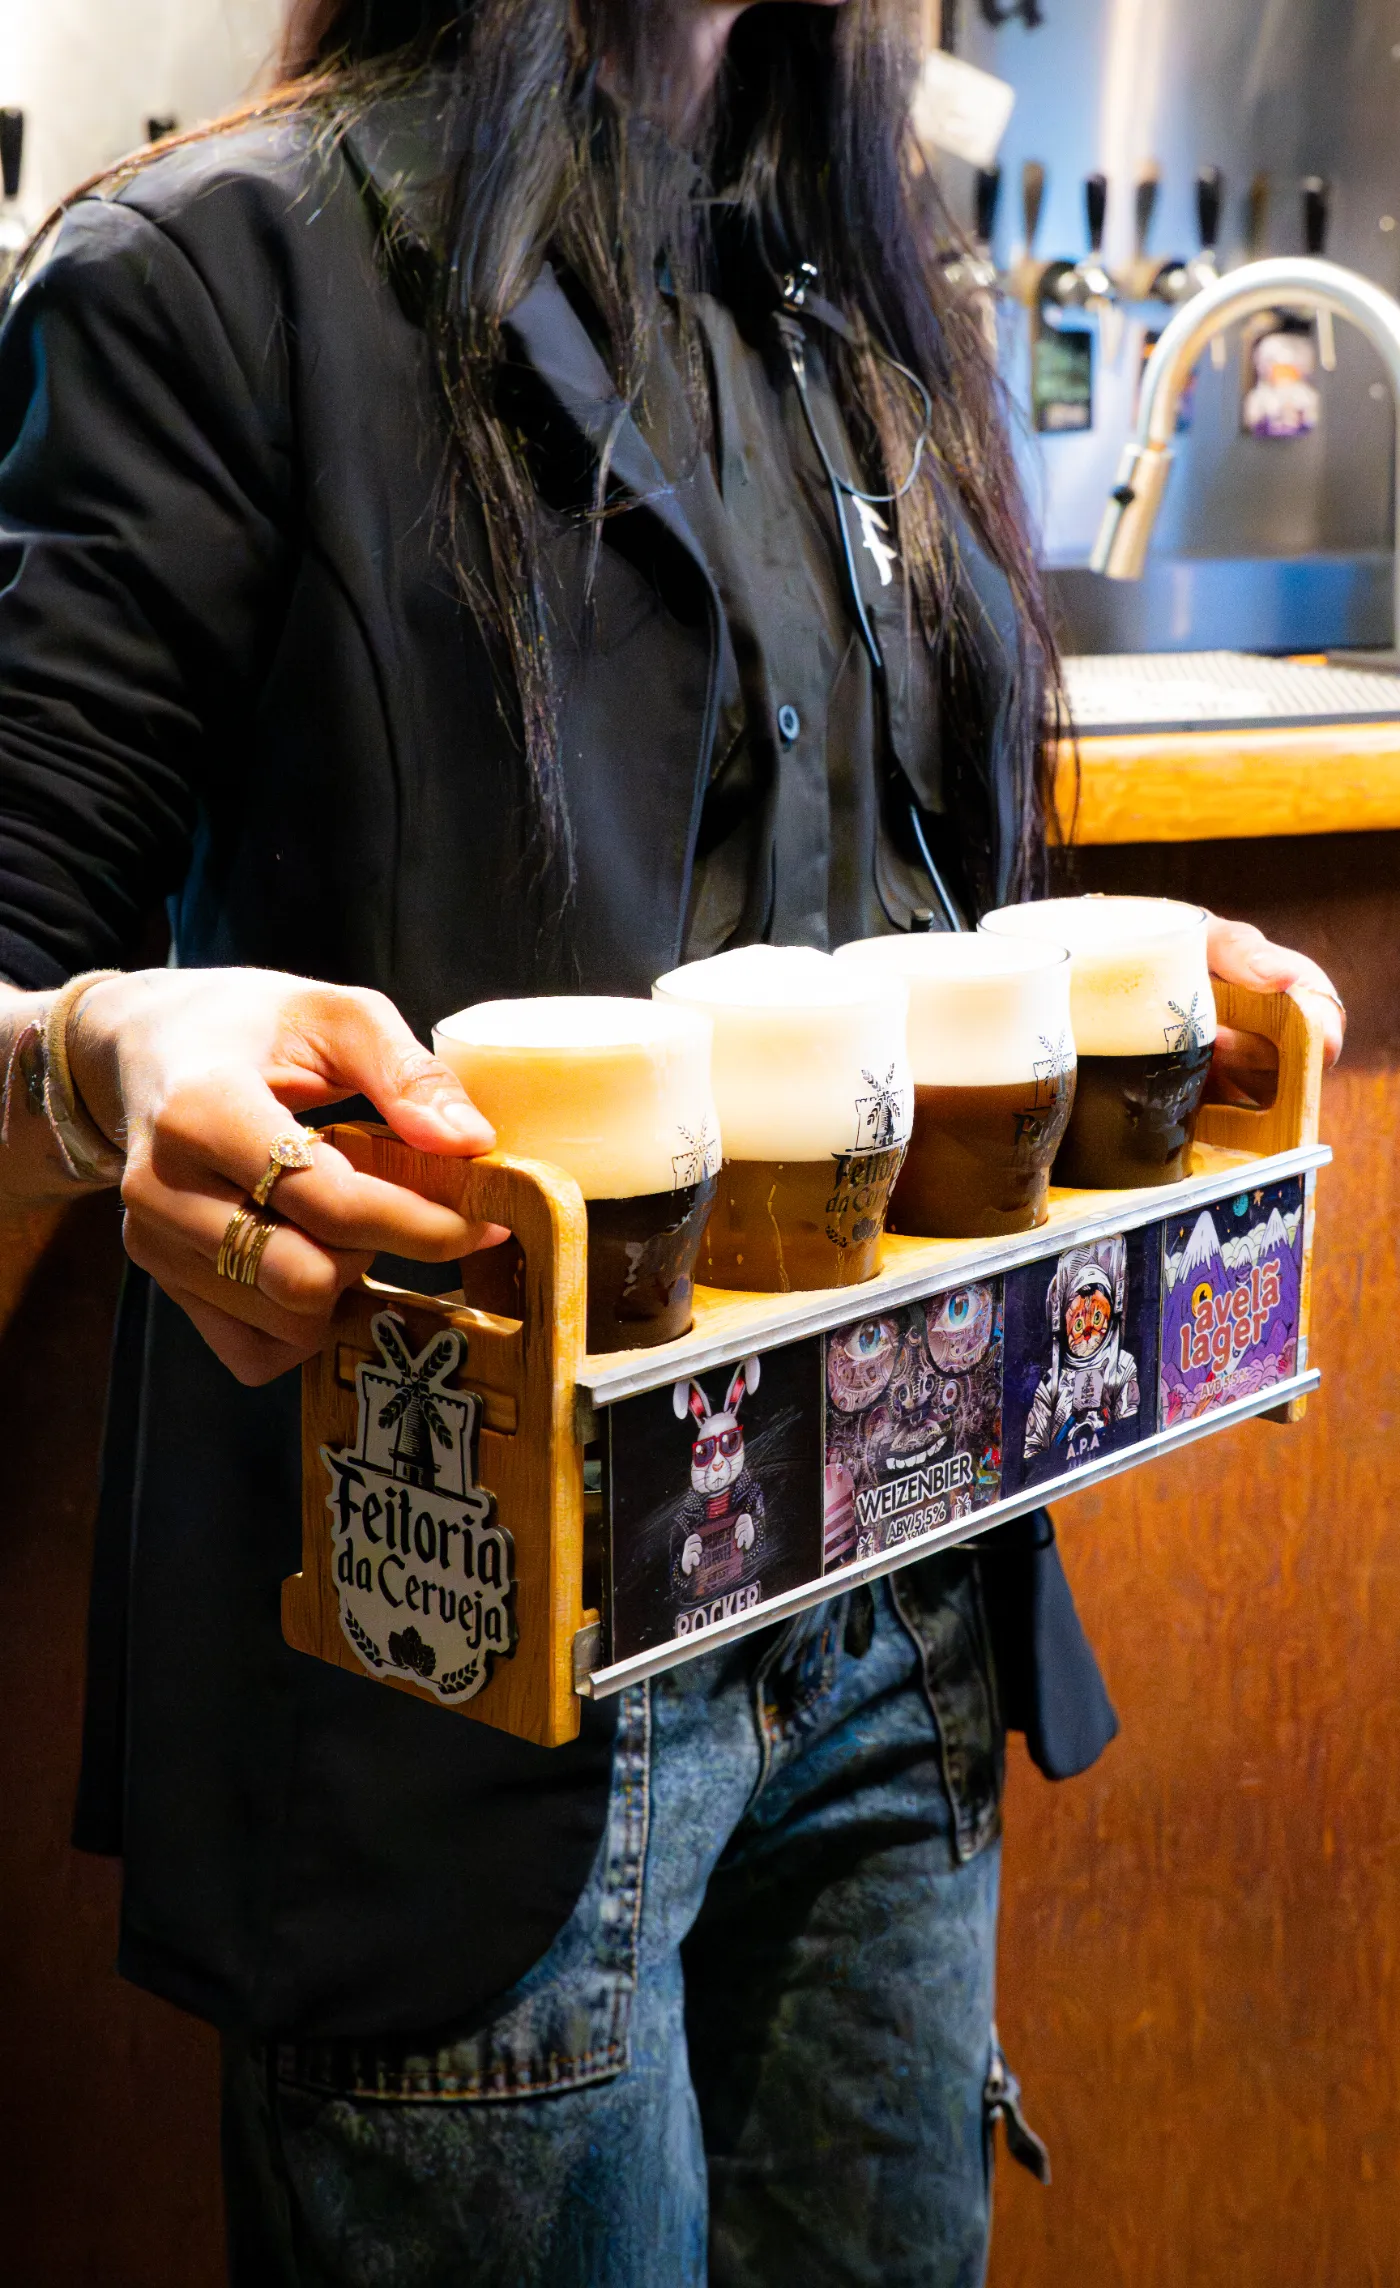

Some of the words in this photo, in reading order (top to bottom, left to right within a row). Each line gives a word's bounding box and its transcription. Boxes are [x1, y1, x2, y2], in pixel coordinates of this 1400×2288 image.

[1194, 1258, 1281, 1334] avelã
[1180, 1308, 1269, 1373] lager
[1200, 1378, 1222, 1400] AVB
[327, 1452, 502, 1590] Feitoria
[857, 1452, 973, 1526] WEIZENBIER
[886, 1514, 914, 1544] ABV
[338, 1537, 373, 1593] da
[378, 1553, 502, 1650] Cerveja
[676, 1584, 760, 1639] ROCKER
